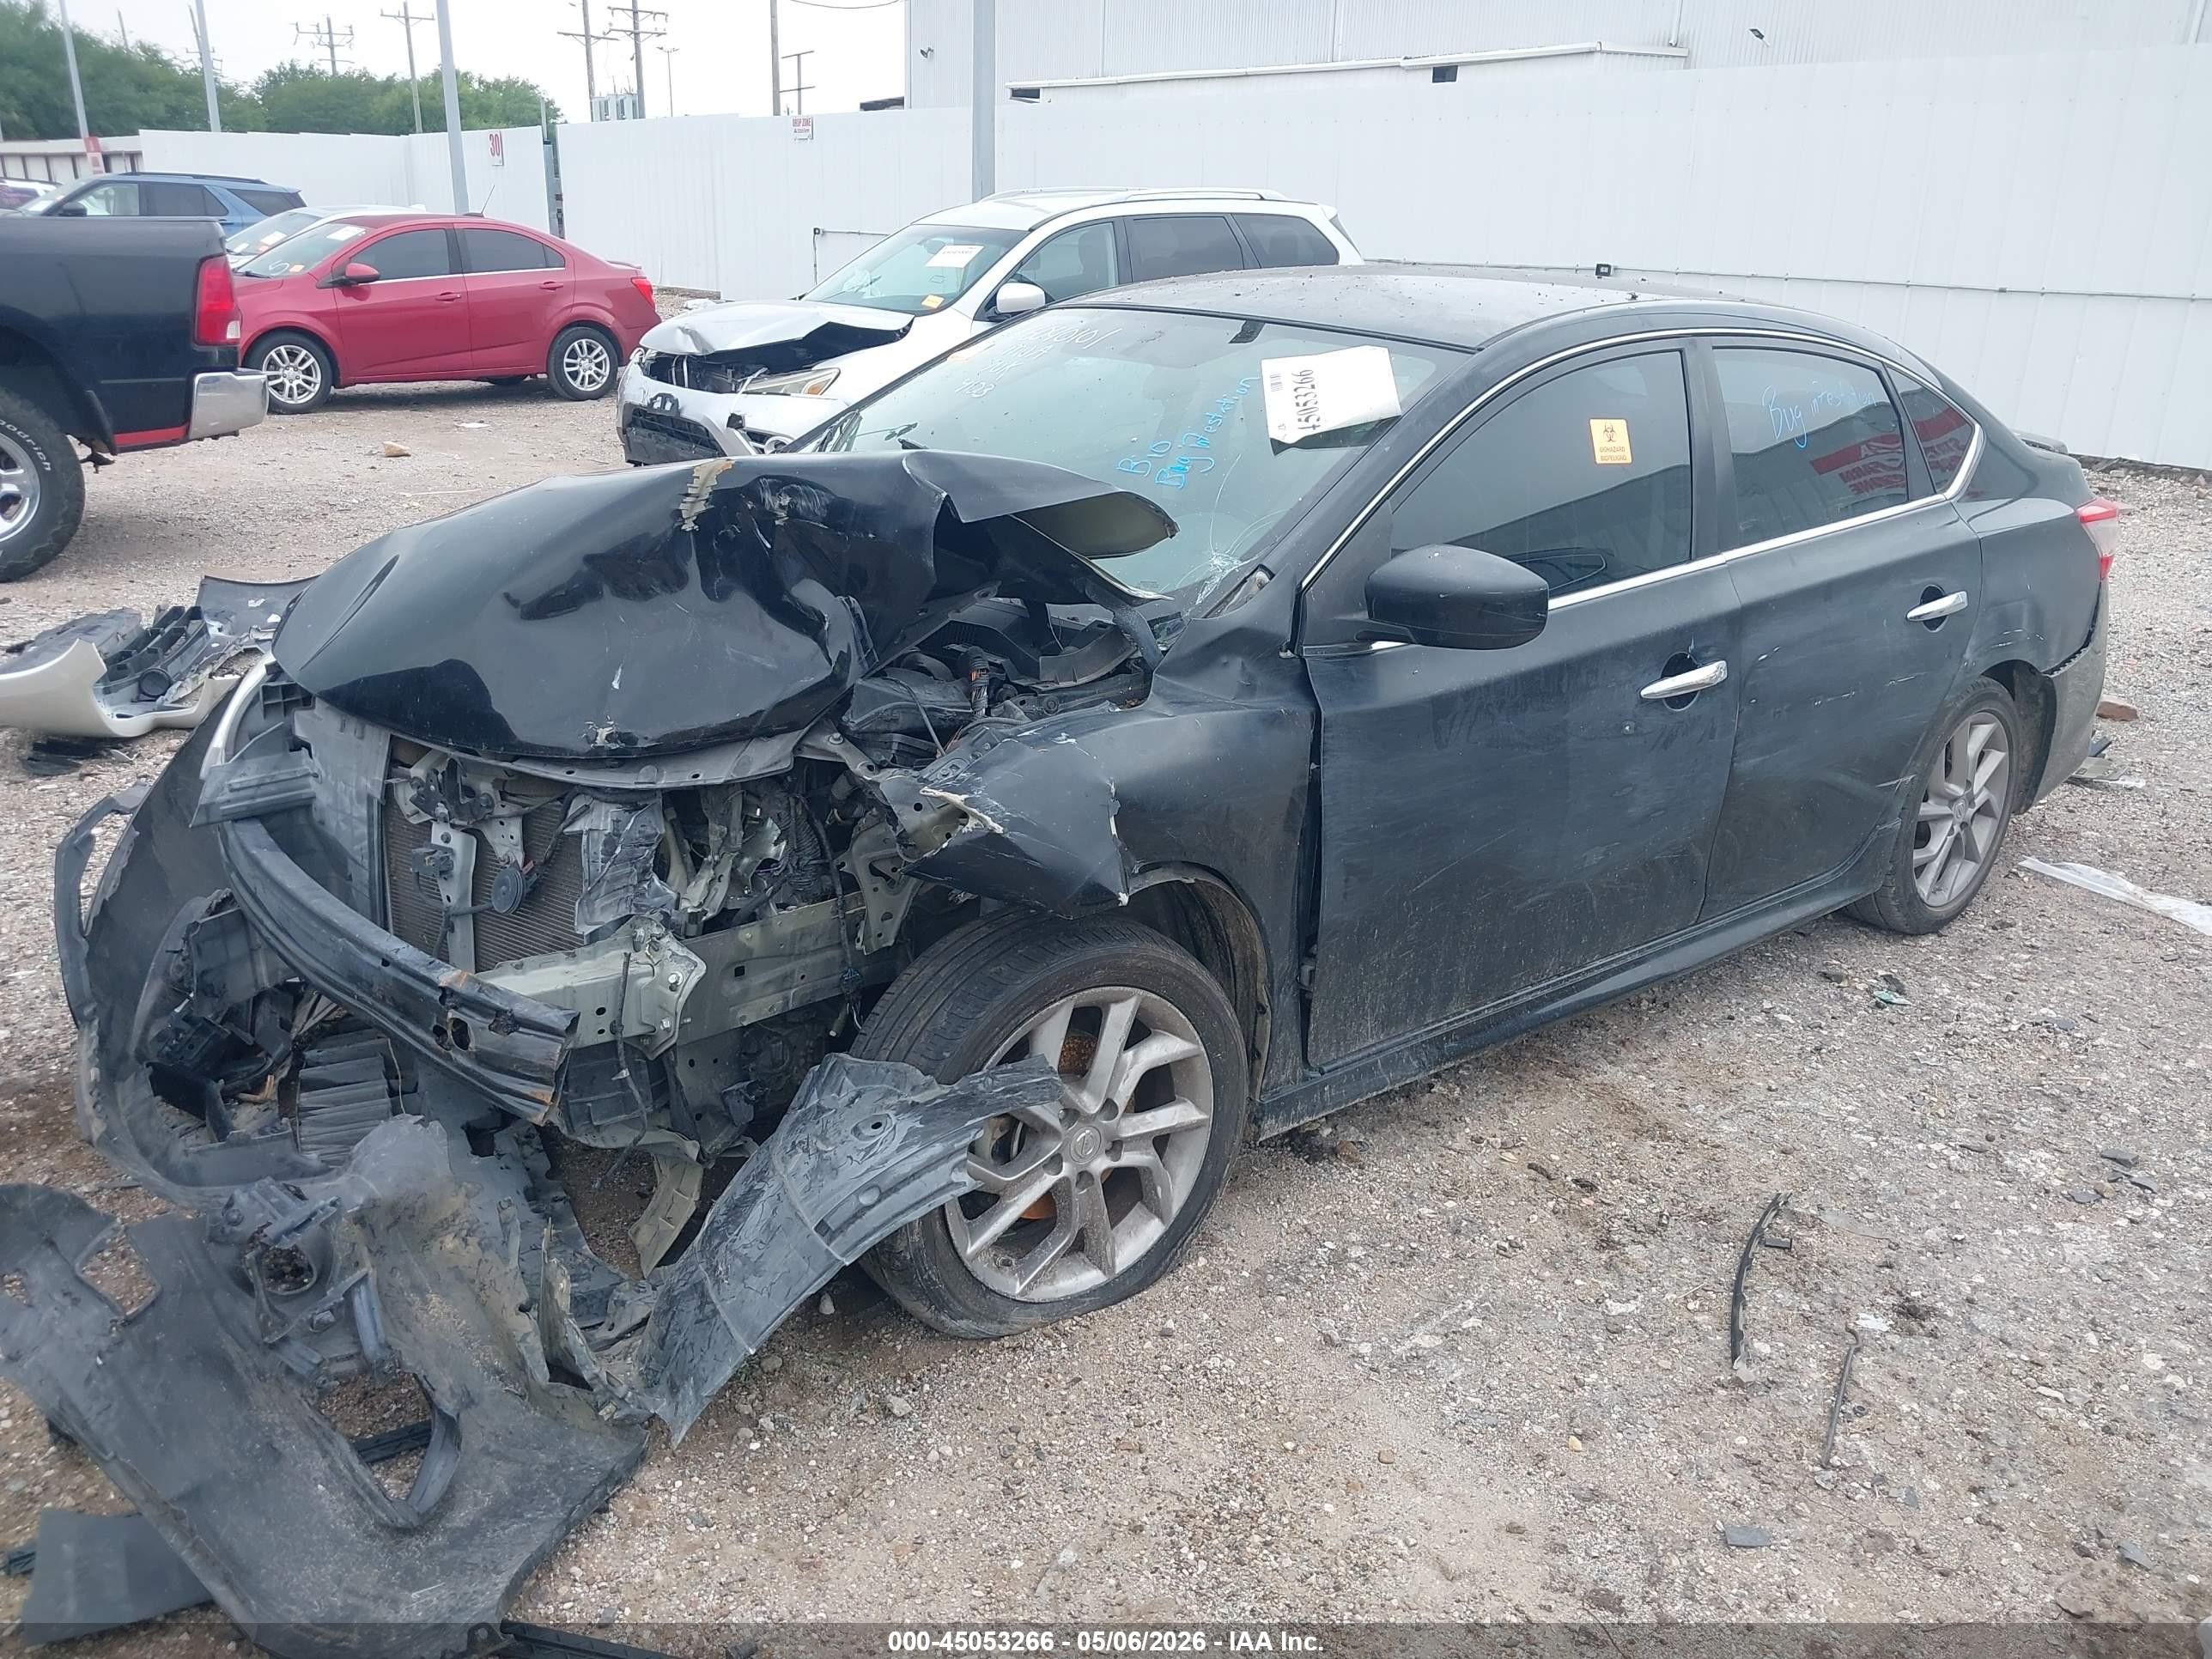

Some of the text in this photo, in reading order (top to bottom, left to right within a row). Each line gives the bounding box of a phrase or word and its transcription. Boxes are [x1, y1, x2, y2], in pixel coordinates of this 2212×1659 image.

[489, 132, 501, 156] 30
[1291, 368, 1322, 430] 45053266
[1762, 380, 1878, 448] Bug infestion
